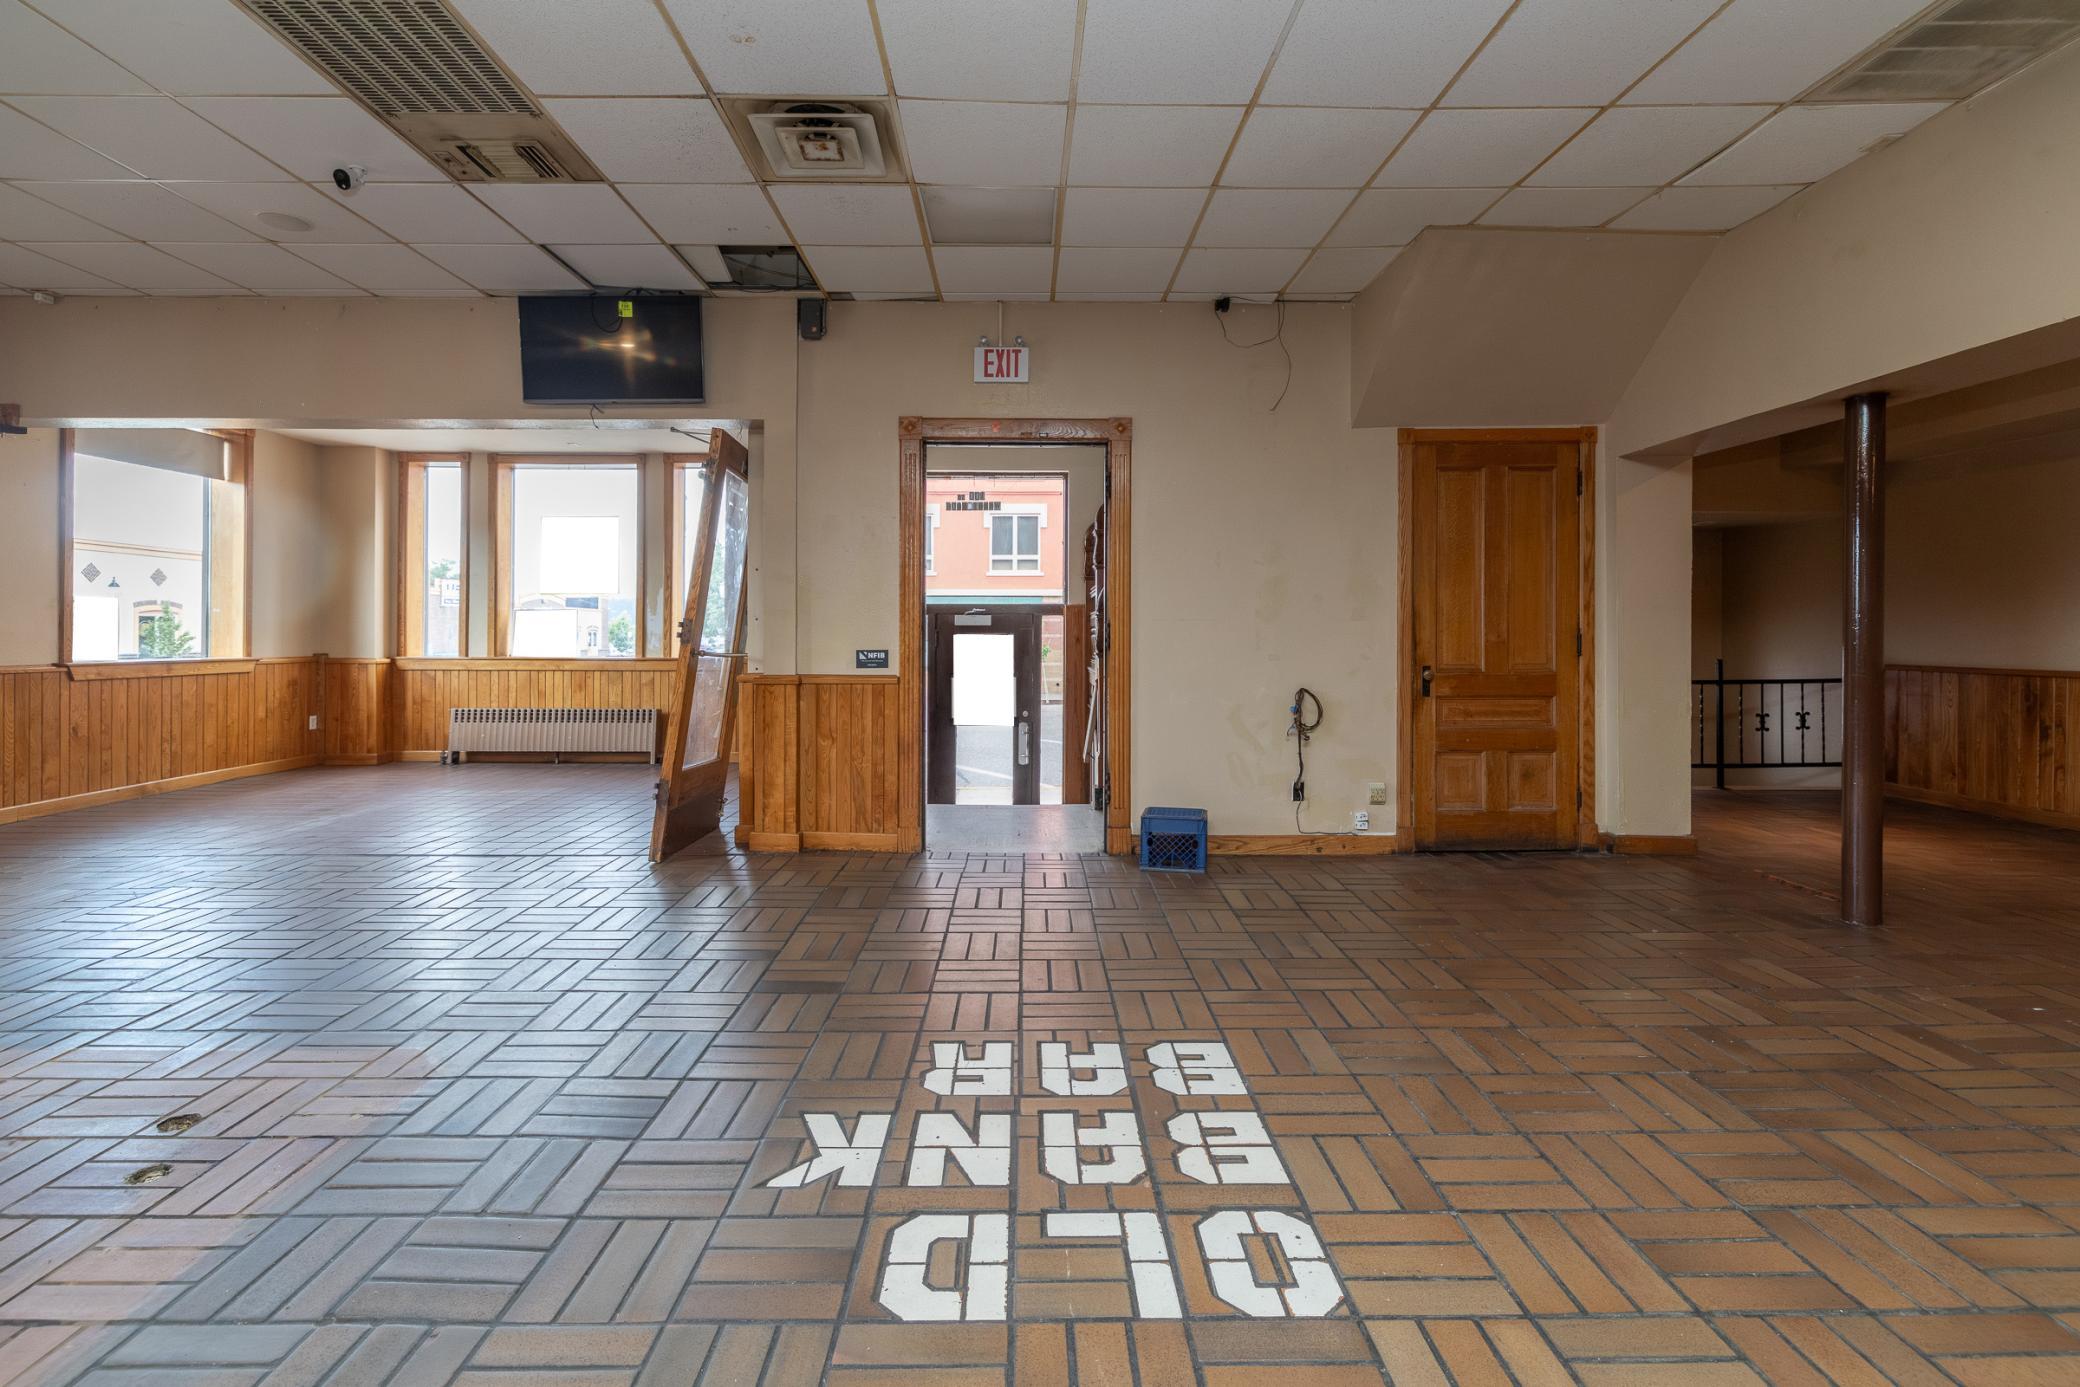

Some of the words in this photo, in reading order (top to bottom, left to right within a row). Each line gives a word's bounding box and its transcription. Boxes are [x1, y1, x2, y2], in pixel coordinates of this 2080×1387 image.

[983, 349, 1022, 378] EXIT
[921, 1041, 1249, 1097] BAR
[765, 1111, 1291, 1187] BANK
[879, 1210, 1344, 1322] OLD
